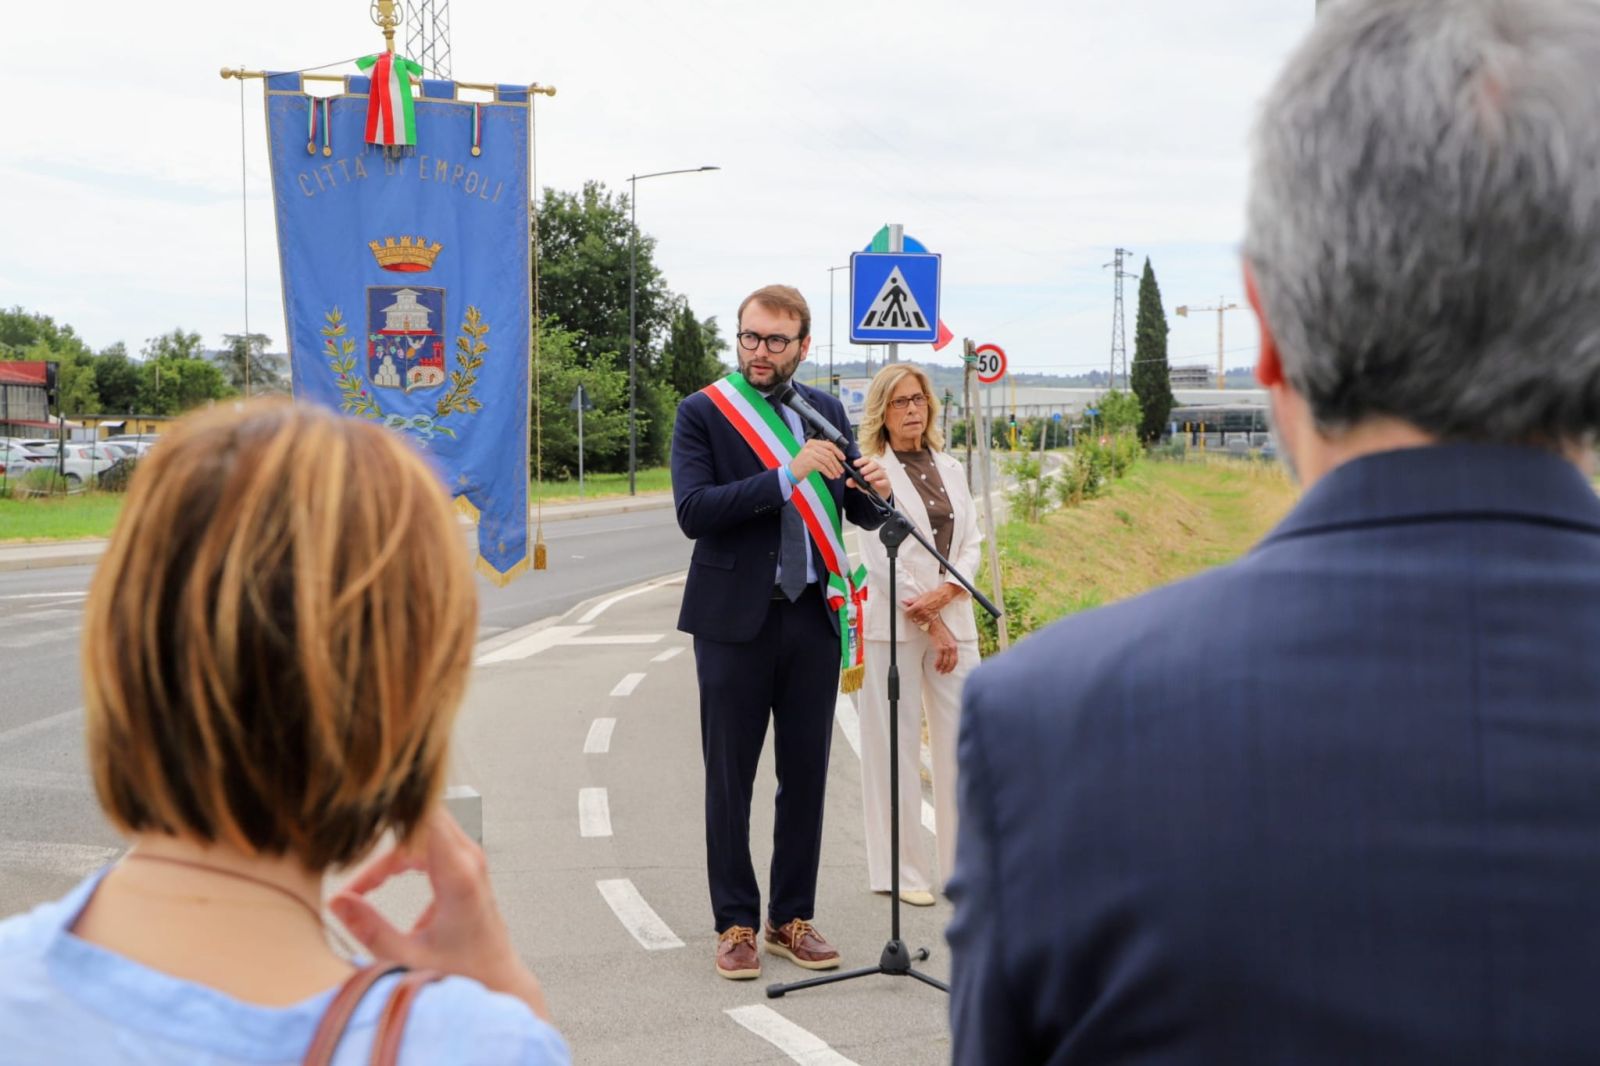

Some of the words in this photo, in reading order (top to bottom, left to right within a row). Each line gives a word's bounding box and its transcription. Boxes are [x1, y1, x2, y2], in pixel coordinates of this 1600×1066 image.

[384, 156, 405, 176] DI
[419, 155, 504, 202] EMPOLI
[979, 355, 999, 372] 50
